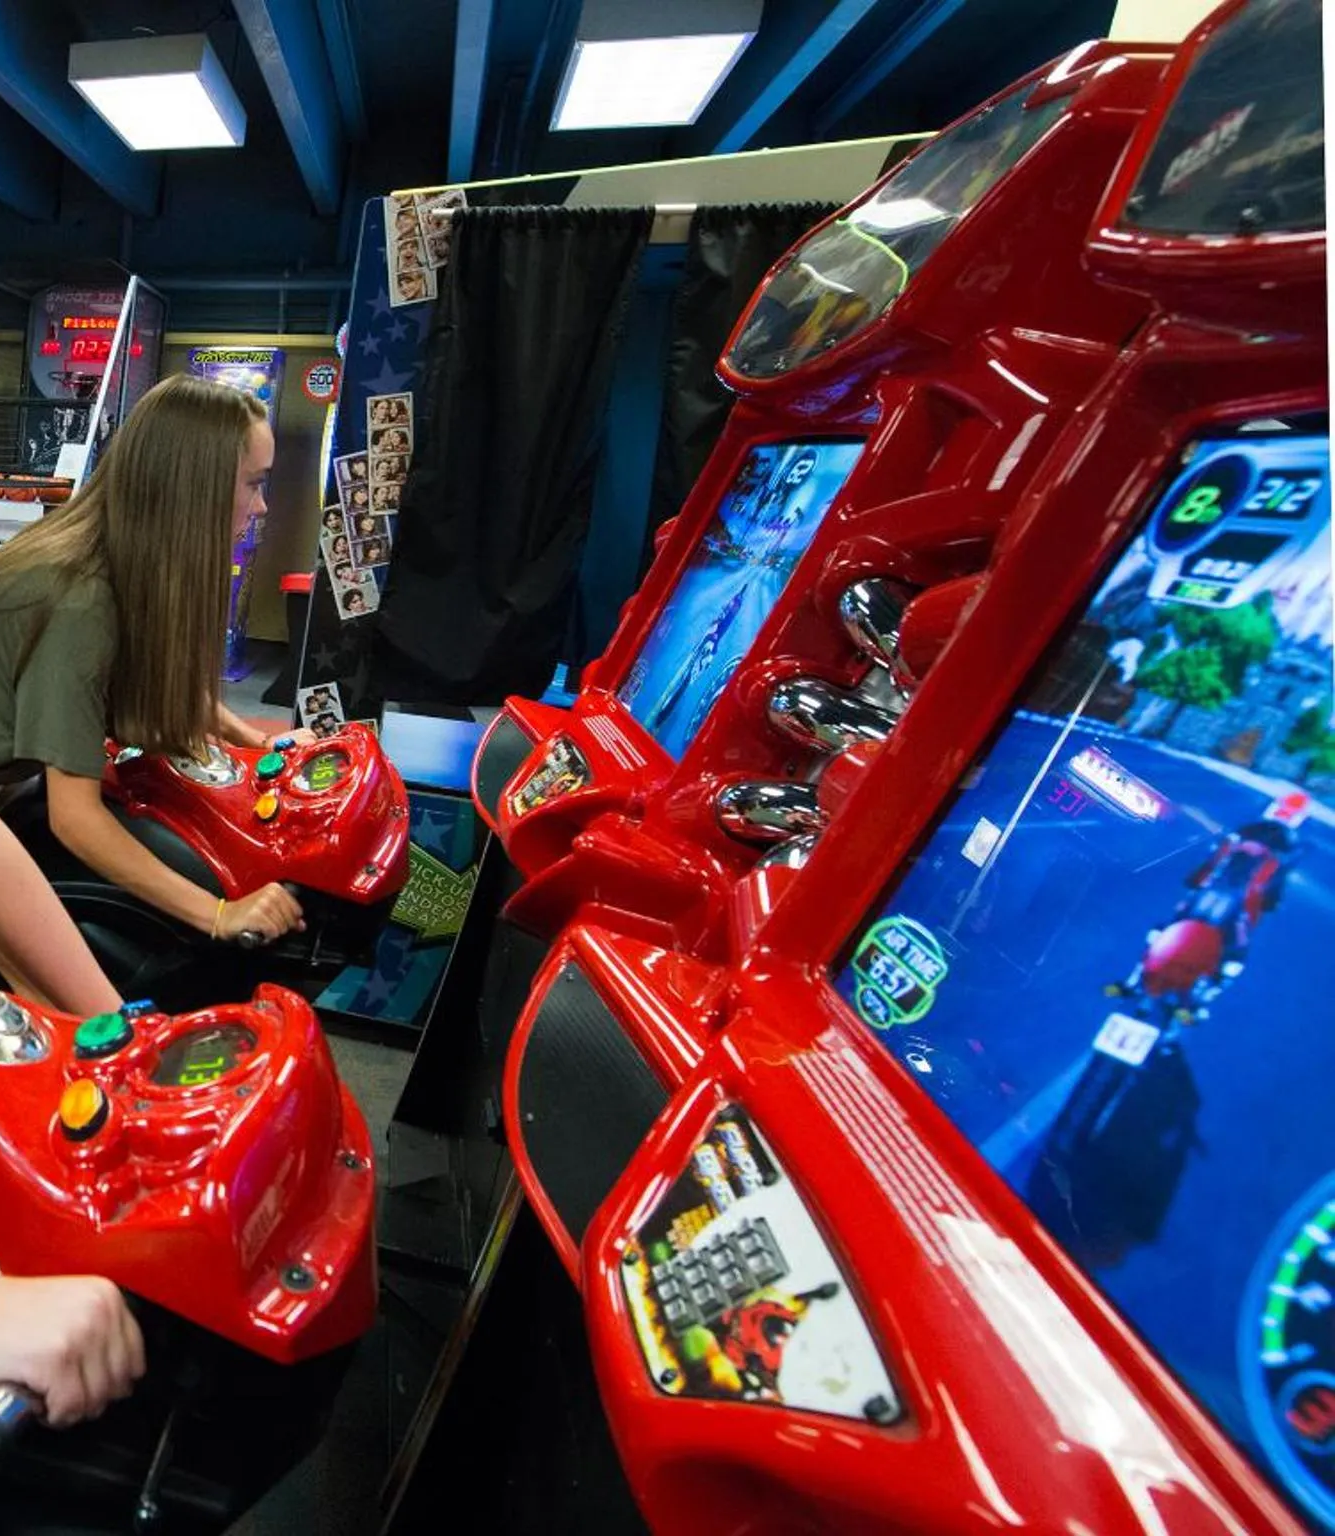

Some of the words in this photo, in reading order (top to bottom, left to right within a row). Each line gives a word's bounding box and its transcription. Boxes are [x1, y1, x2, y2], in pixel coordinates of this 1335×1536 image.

[309, 372, 334, 385] 500
[396, 900, 438, 927] SEAT
[882, 927, 909, 953] AIR
[902, 944, 942, 981] TIME
